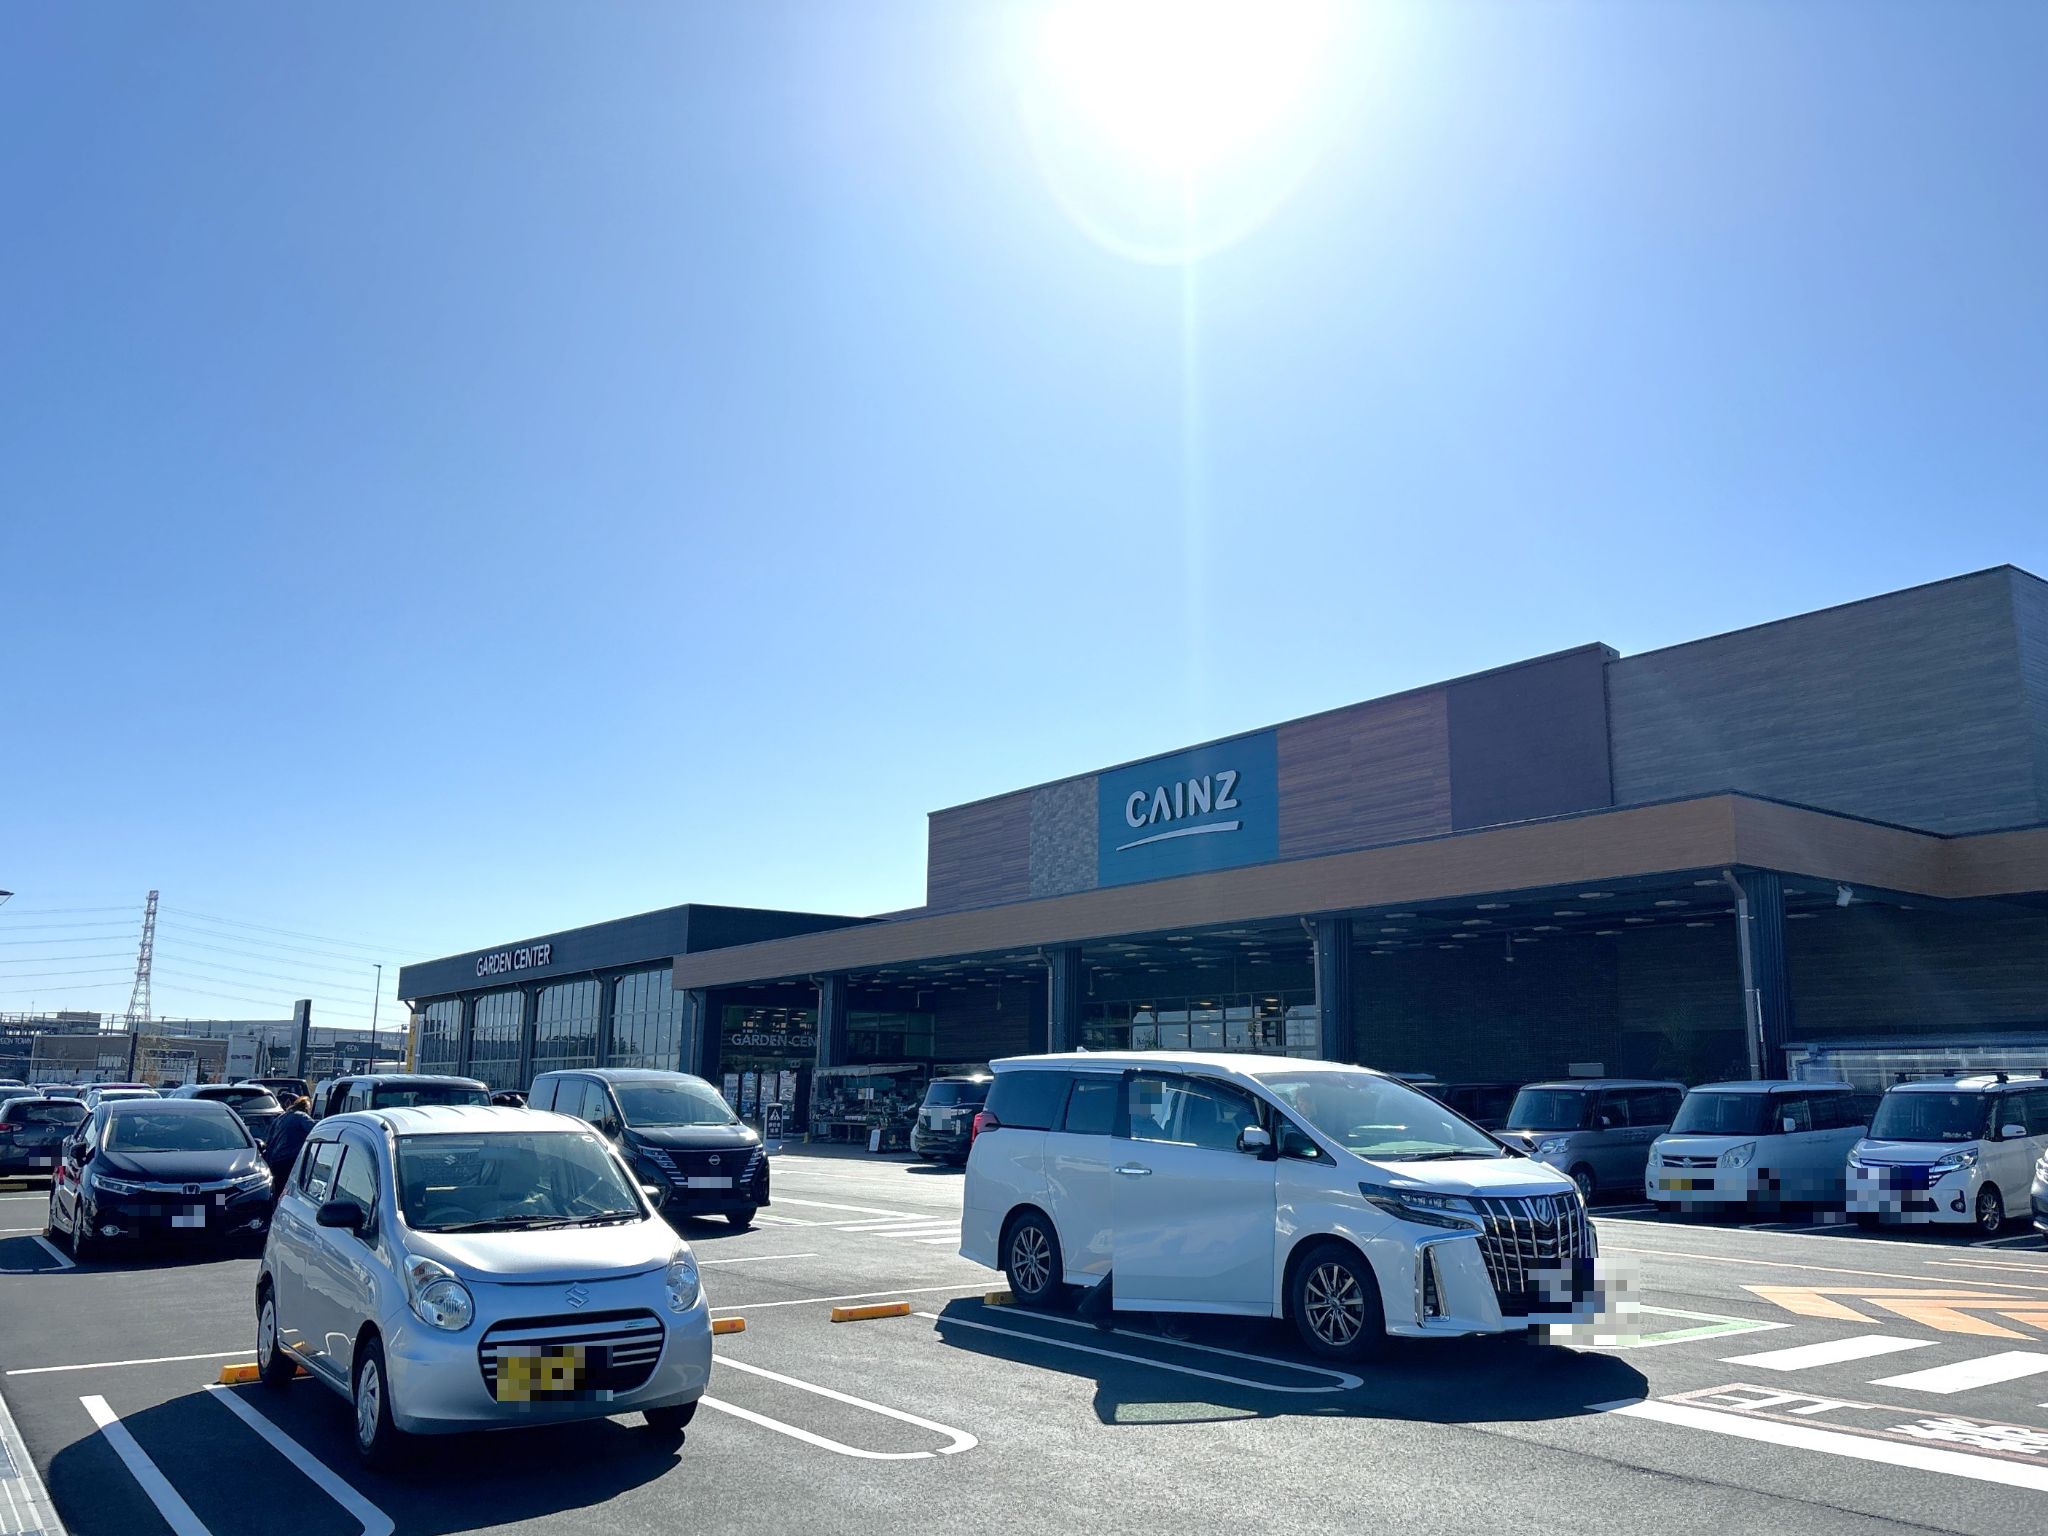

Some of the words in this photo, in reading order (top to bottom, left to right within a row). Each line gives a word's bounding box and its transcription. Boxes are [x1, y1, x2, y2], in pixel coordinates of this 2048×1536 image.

[1125, 770, 1238, 828] CAINZ
[476, 951, 513, 977] GARDEN
[513, 943, 551, 970] CENTER
[731, 1033, 788, 1047] GARDEN
[791, 1035, 817, 1048] CEN
